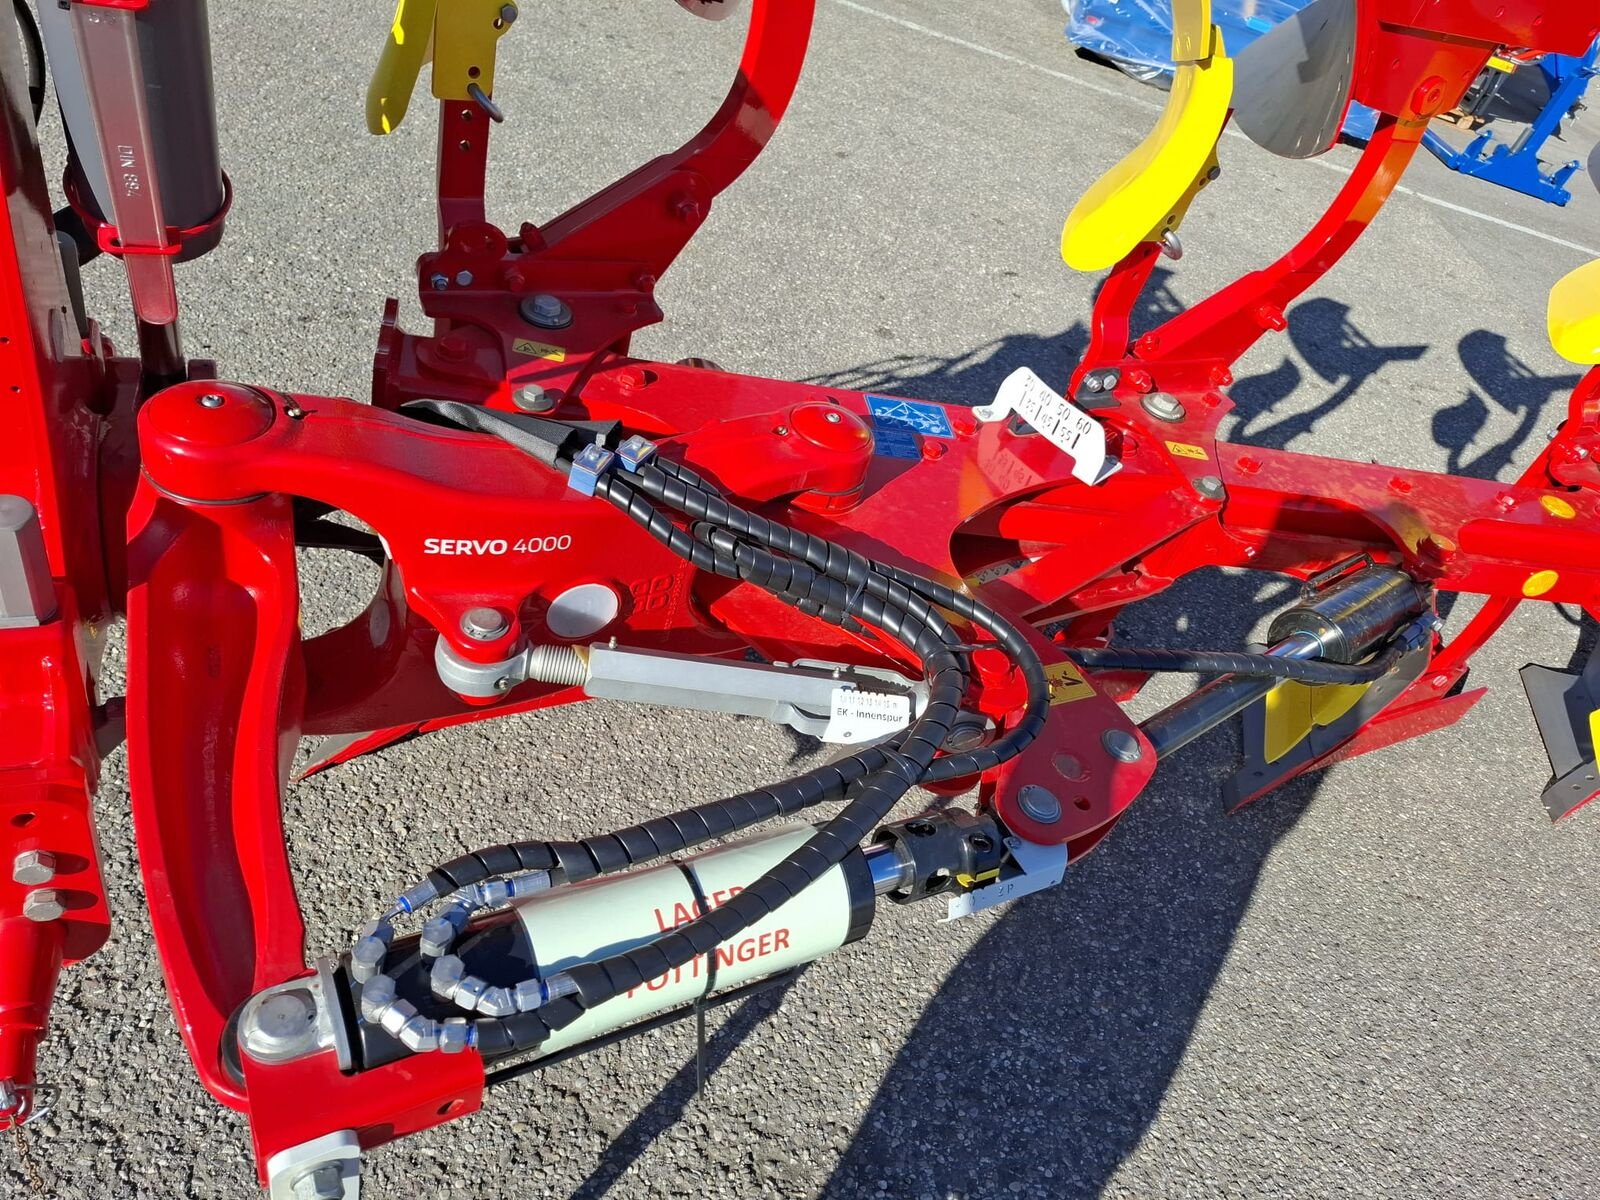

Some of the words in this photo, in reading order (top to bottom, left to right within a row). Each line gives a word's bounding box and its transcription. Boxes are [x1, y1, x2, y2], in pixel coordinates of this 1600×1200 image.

[117, 145, 136, 168] DIN
[1056, 403, 1070, 421] 50
[1076, 417, 1092, 435] 60
[1060, 426, 1071, 441] 55
[424, 538, 507, 556] SERVO
[513, 535, 572, 553] 4000
[837, 707, 848, 716] EK
[856, 709, 903, 722] Innenspur
